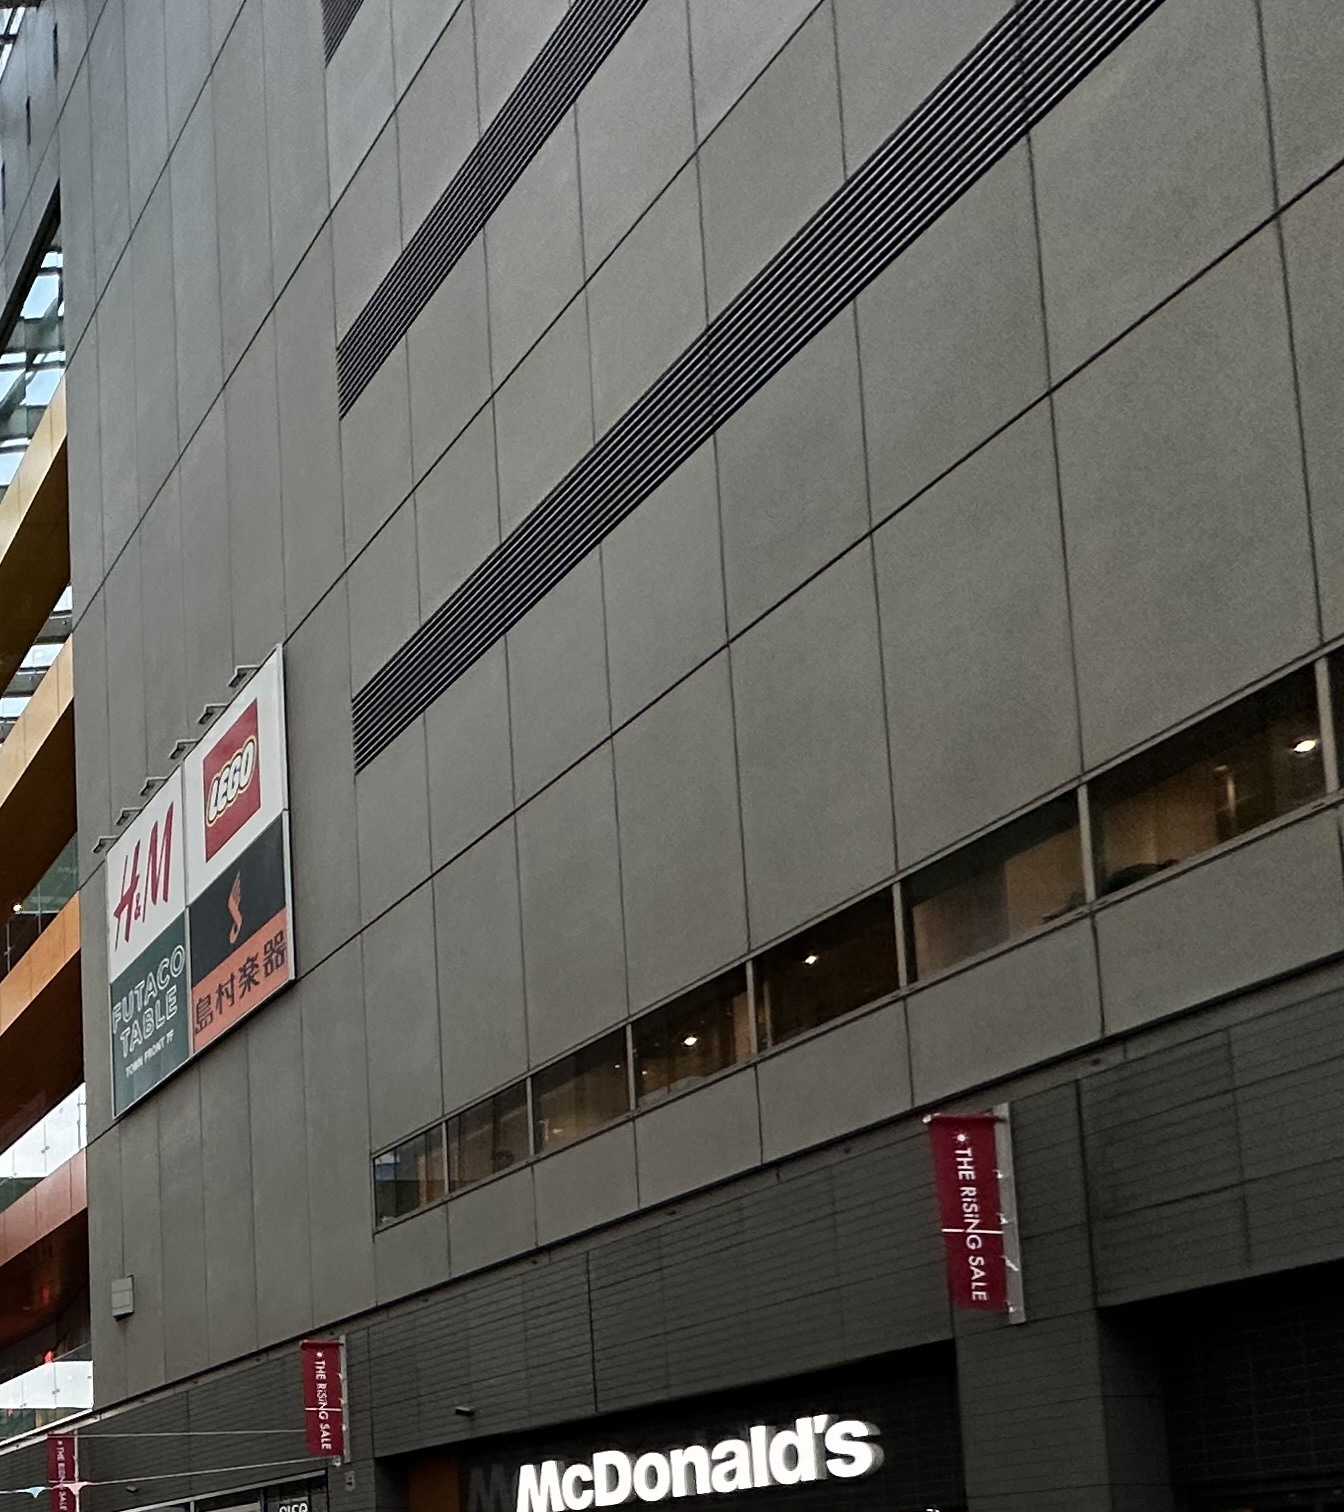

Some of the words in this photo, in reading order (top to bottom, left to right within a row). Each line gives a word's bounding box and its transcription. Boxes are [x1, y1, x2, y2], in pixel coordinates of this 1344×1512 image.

[207, 736, 256, 826] LEGO
[113, 801, 174, 952] H&M
[113, 944, 186, 1035] FUTACO
[119, 984, 178, 1059] TABLE
[195, 929, 287, 1035] 島村楽器
[954, 1147, 976, 1180] THE
[967, 1255, 988, 1301] SALE
[314, 1360, 327, 1381] THE
[320, 1422, 332, 1450] SALE
